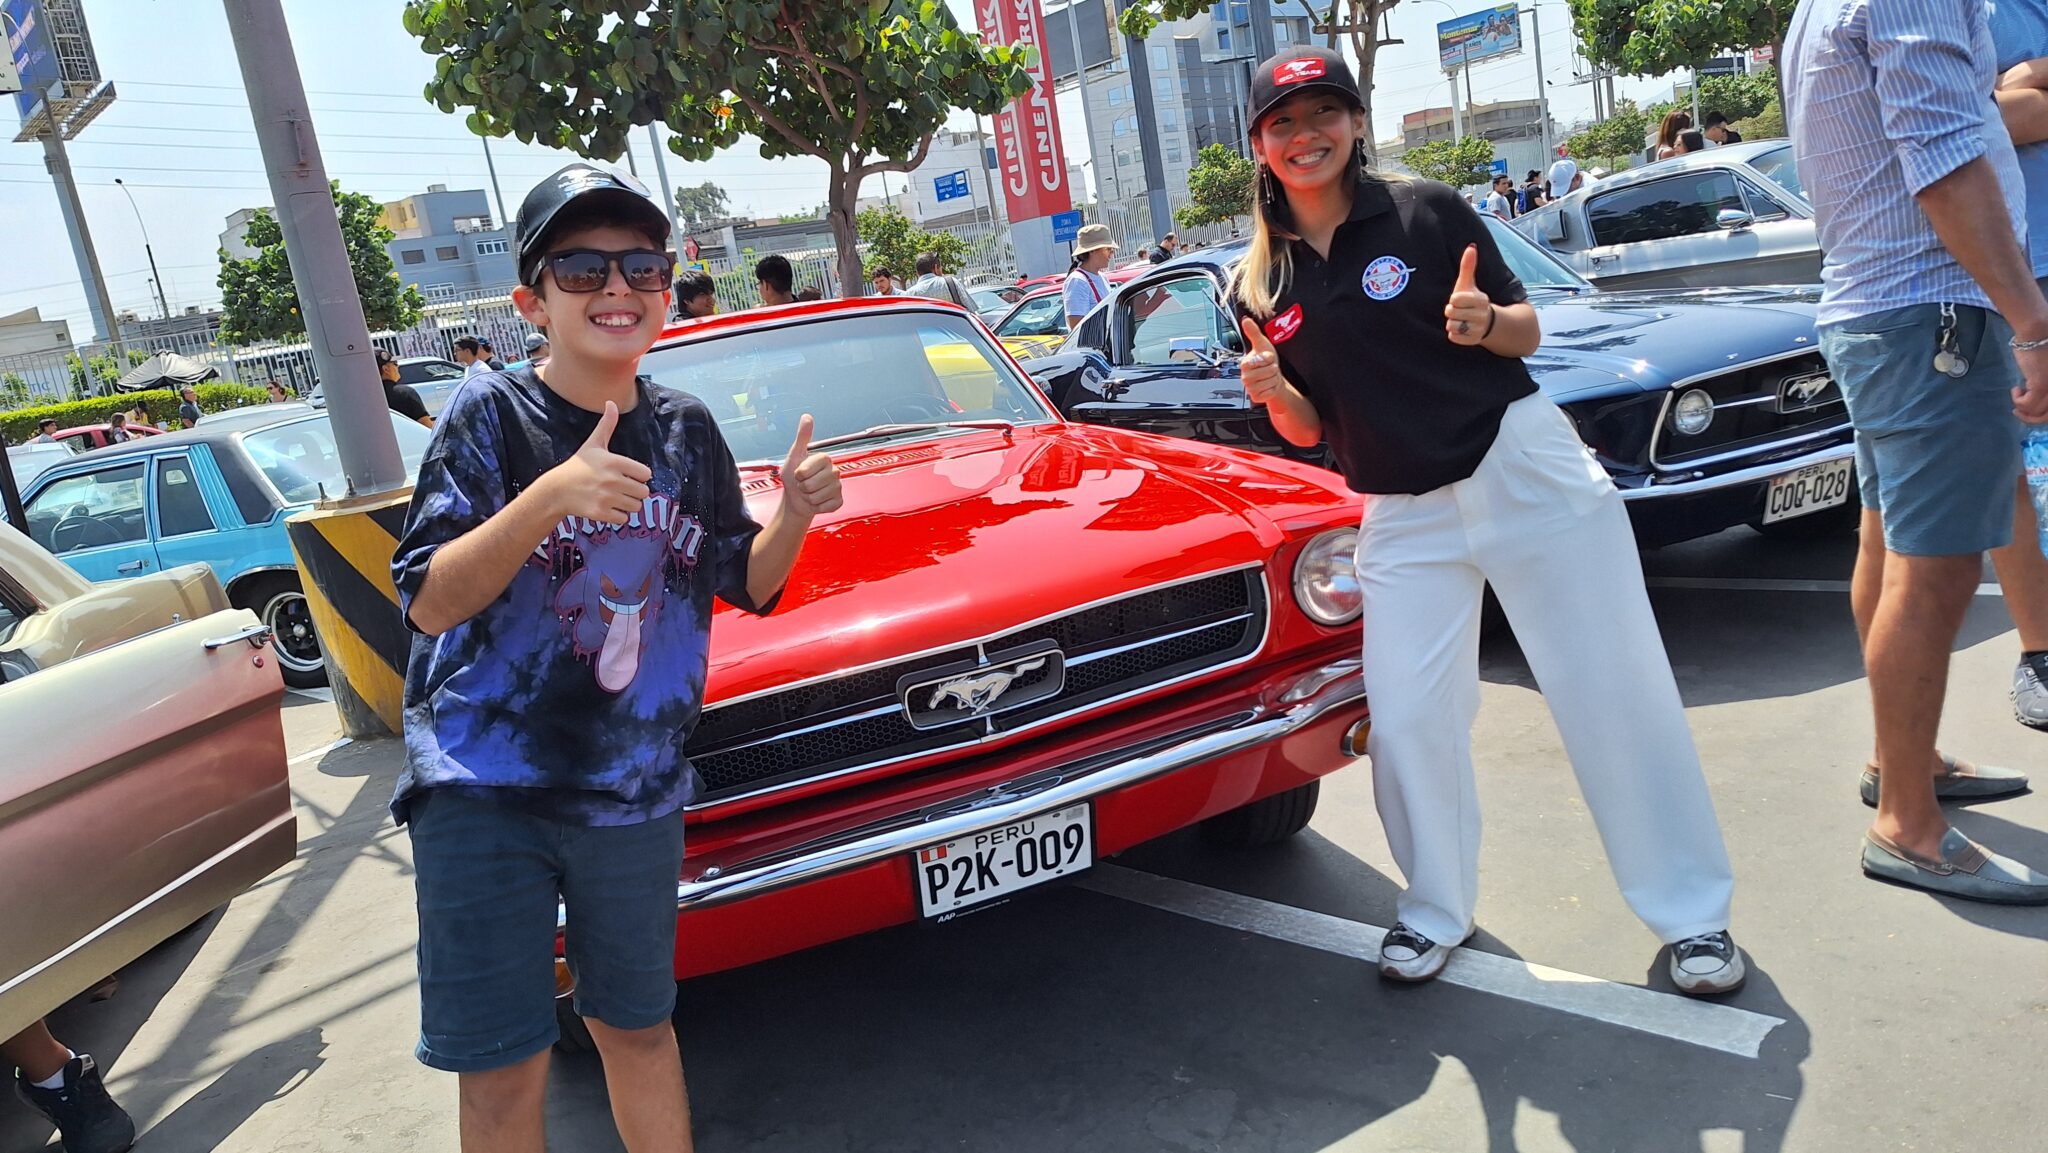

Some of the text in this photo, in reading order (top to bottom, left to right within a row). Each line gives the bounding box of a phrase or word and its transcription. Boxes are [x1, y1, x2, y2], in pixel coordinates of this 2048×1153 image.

[982, 0, 1028, 196] CINERK
[1015, 0, 1060, 191] CINEMRK
[1797, 464, 1828, 480] PERU
[975, 821, 1035, 850] PERU
[925, 823, 1084, 905] P2K-009
[937, 912, 956, 923] AAP
